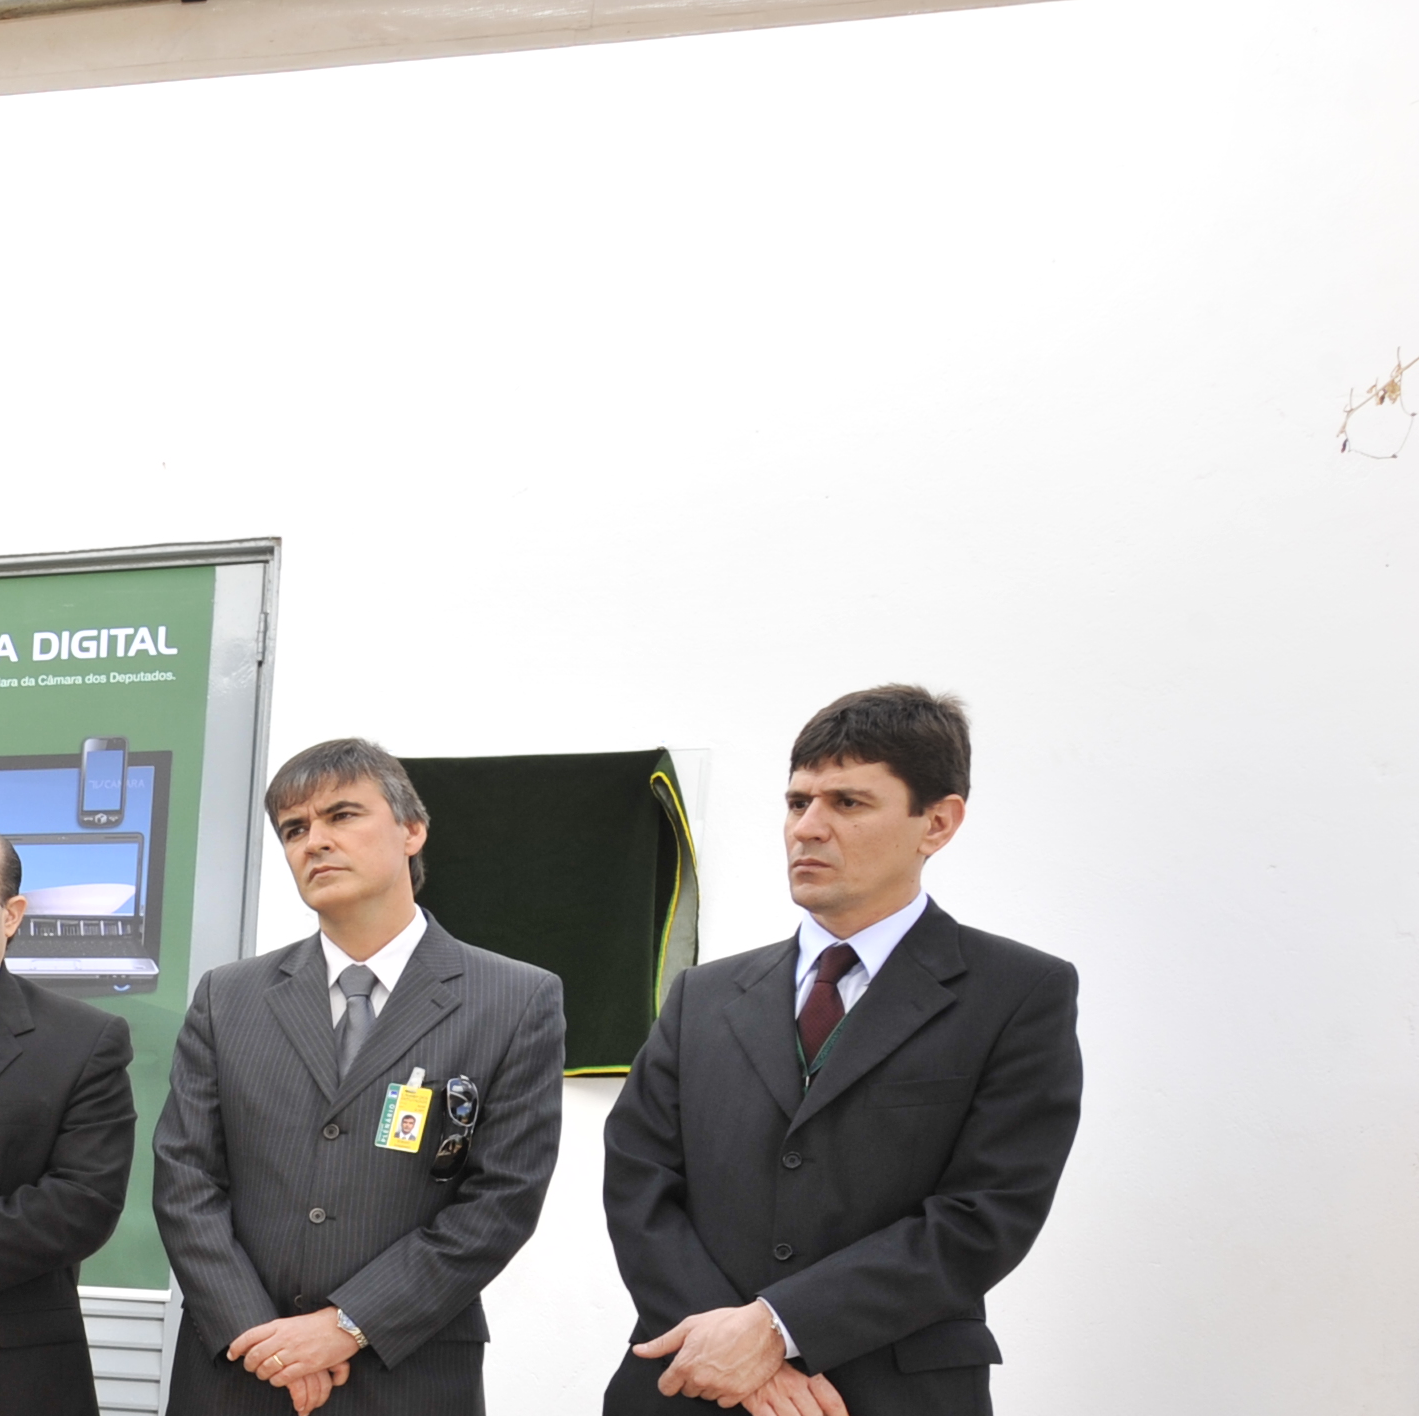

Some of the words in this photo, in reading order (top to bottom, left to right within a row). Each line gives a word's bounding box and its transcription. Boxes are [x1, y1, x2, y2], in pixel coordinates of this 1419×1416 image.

[32, 625, 179, 662] DIGITAL
[20, 674, 36, 687] da
[37, 673, 83, 686] Câmara
[84, 671, 107, 684] dos
[109, 669, 177, 685] Deputados.
